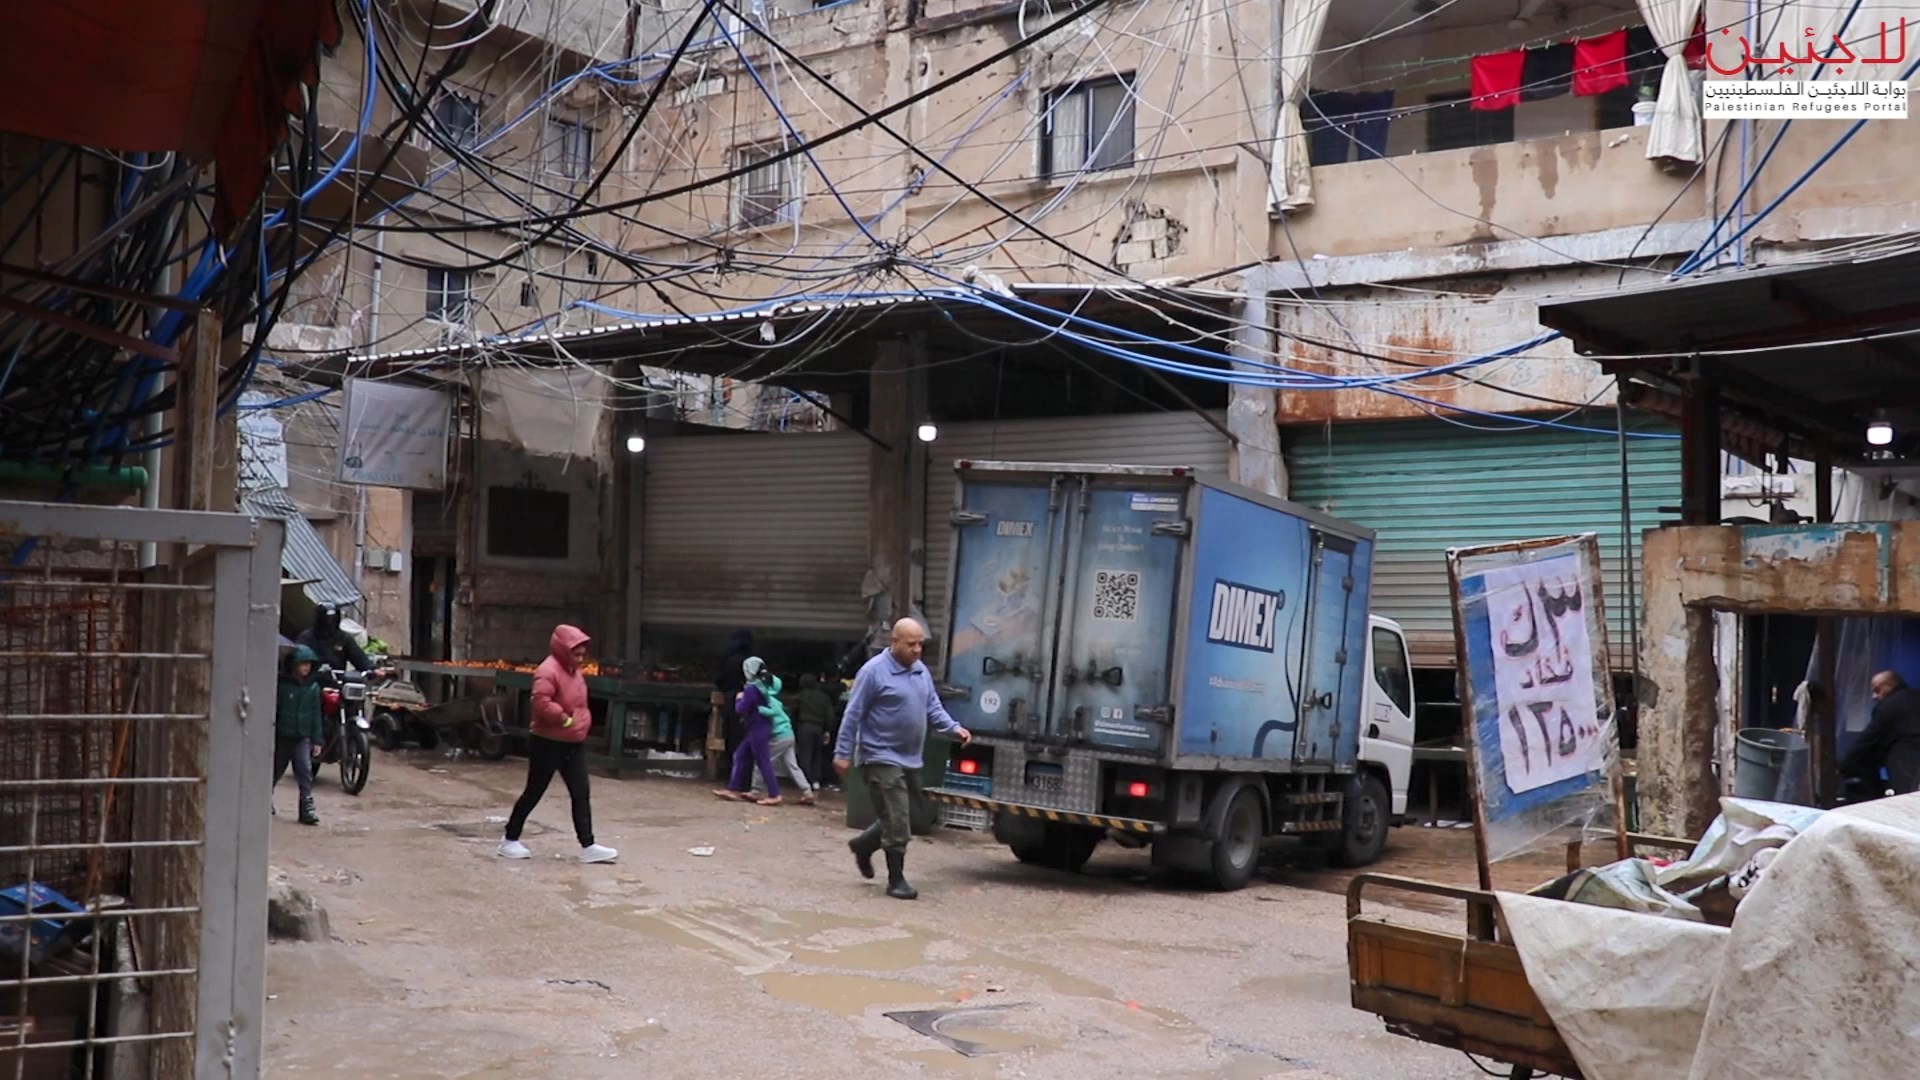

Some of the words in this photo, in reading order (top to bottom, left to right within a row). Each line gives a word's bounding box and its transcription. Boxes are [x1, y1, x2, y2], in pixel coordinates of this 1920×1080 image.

[996, 521, 1034, 536] DIMEX
[1208, 582, 1279, 649] DIMEX
[984, 697, 997, 706] 192
